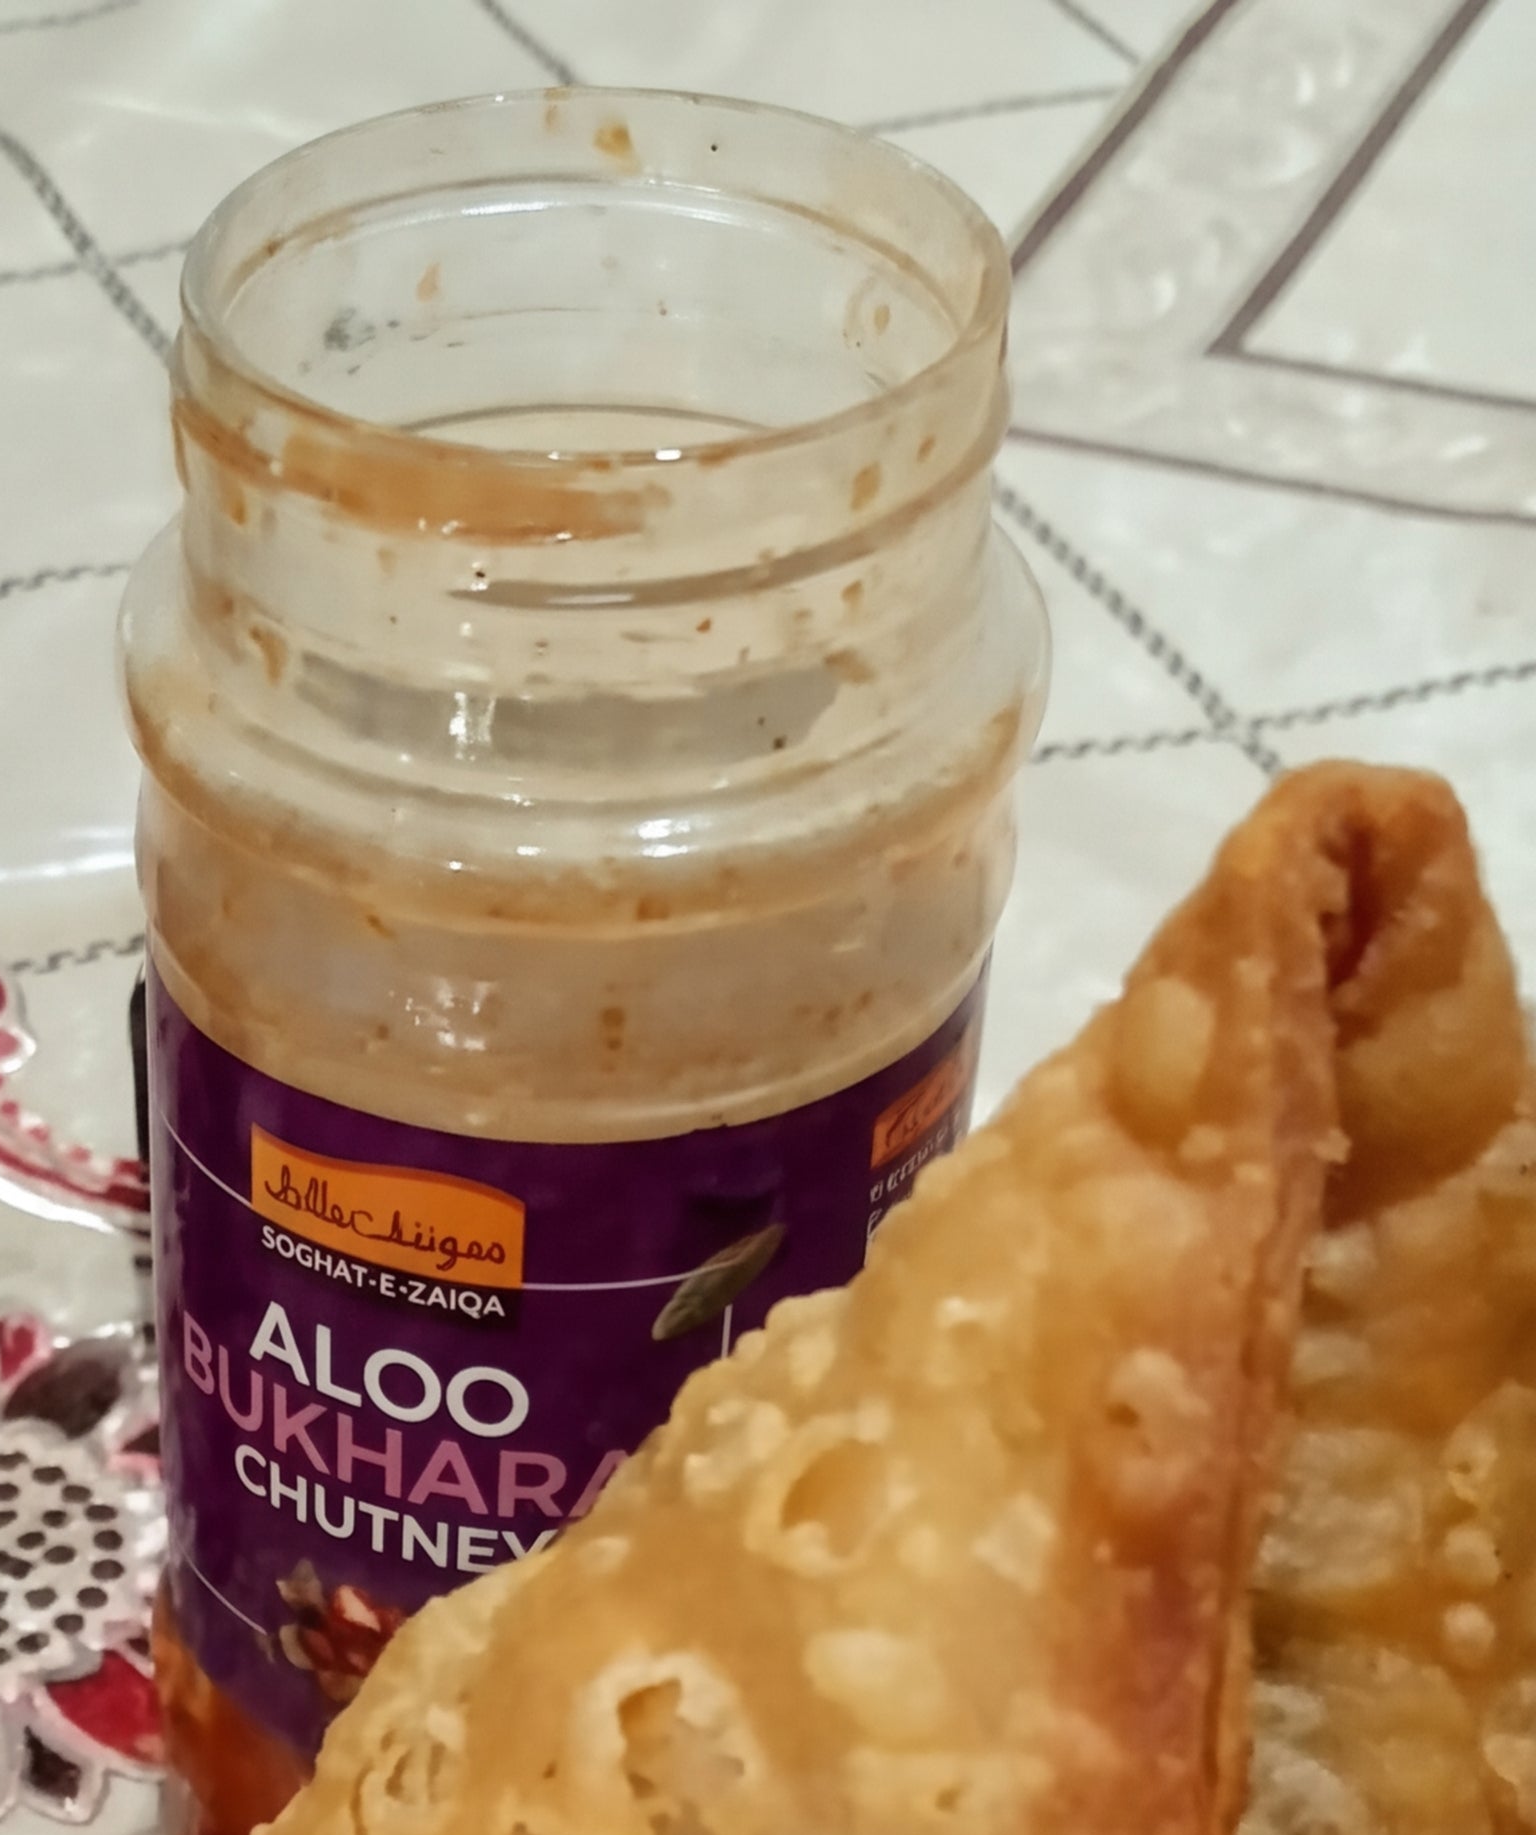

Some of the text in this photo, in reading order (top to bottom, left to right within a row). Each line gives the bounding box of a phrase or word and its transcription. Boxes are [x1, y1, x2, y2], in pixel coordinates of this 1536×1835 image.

[261, 1225, 506, 1319] SOGHAT-E-ZAIQA
[249, 1301, 530, 1438] ALOO
[234, 1444, 560, 1574] CHUTNEY
